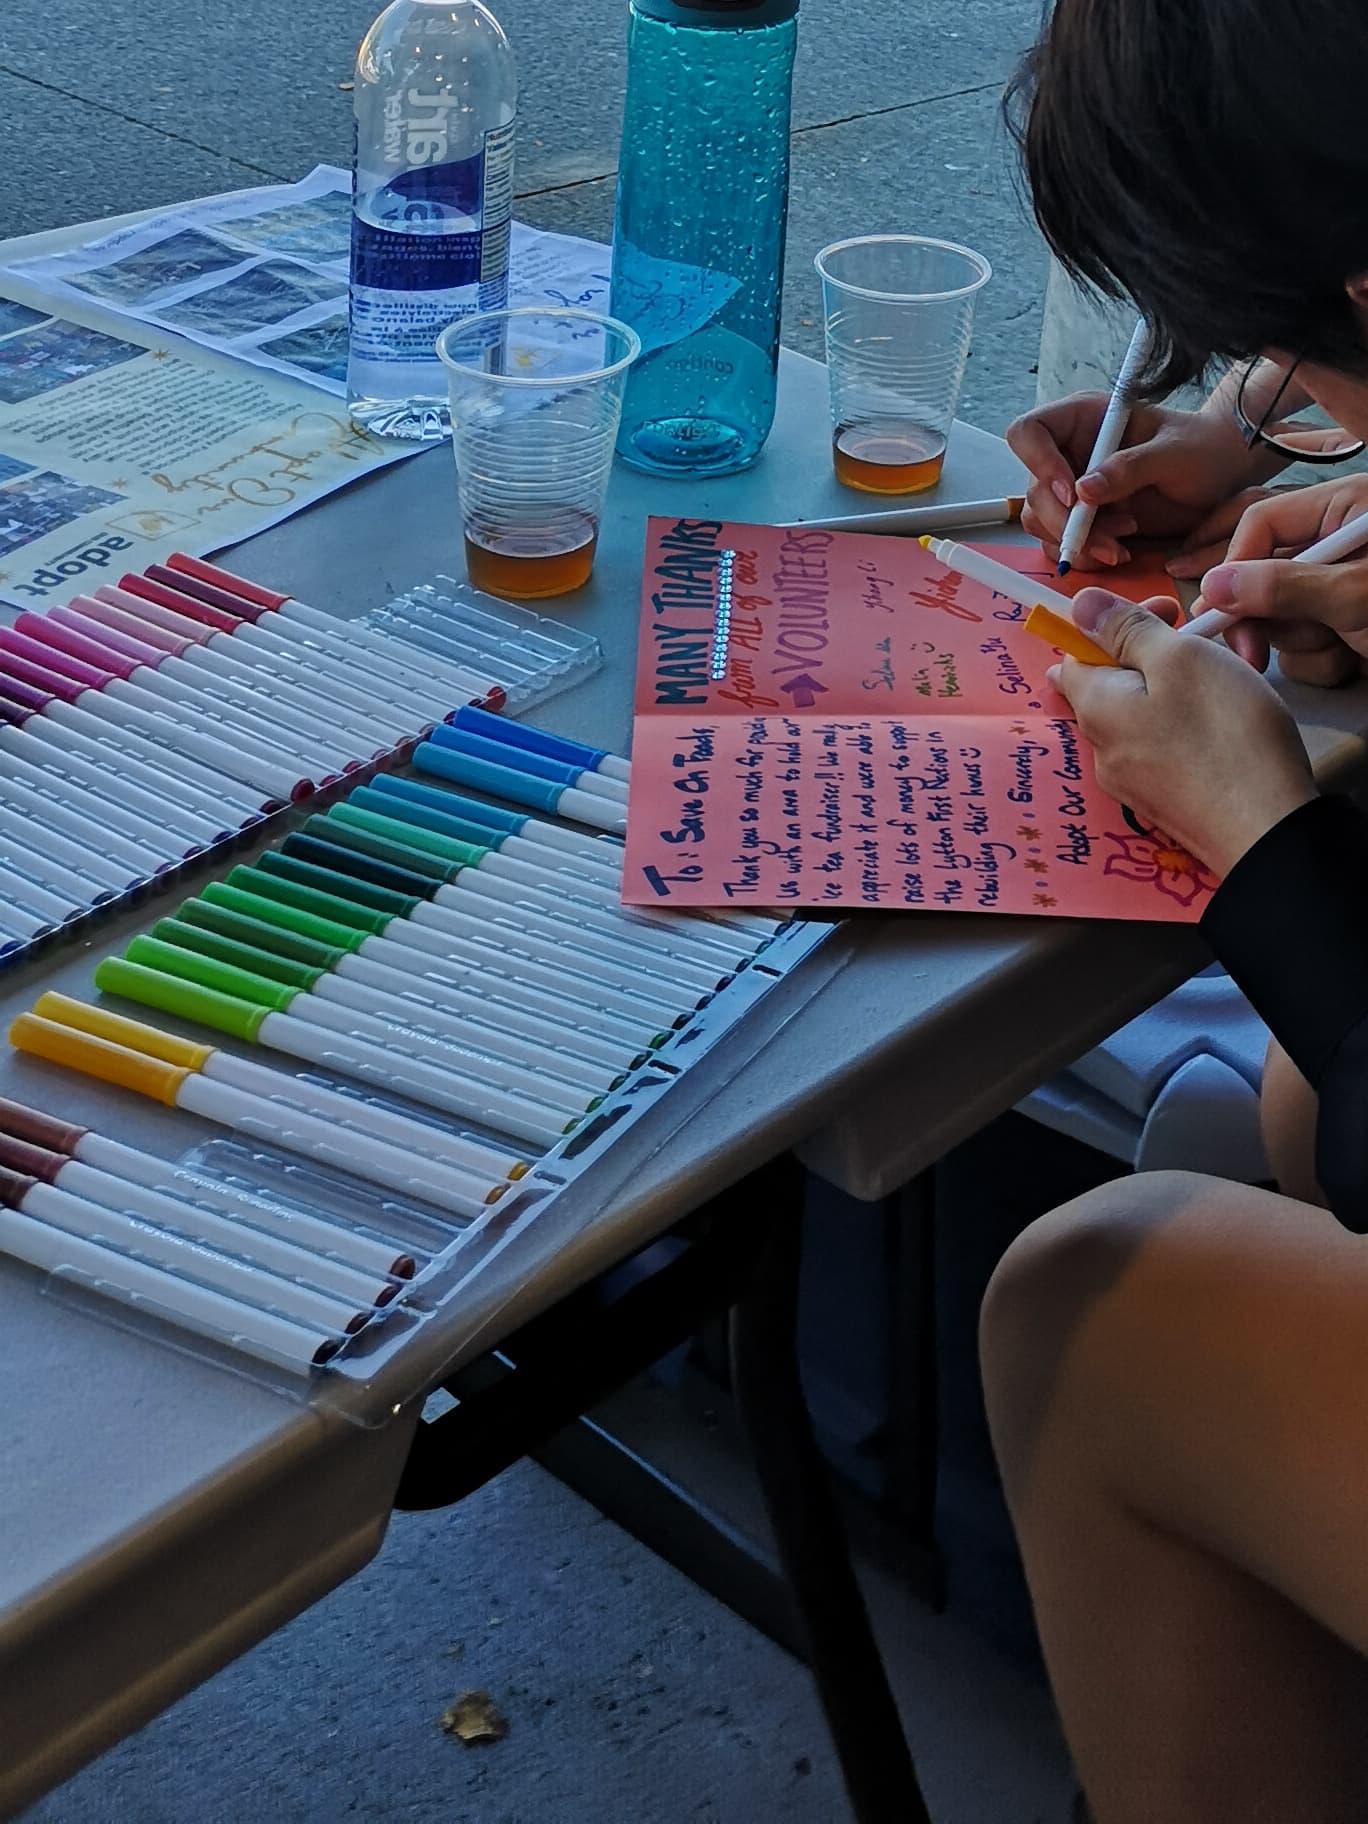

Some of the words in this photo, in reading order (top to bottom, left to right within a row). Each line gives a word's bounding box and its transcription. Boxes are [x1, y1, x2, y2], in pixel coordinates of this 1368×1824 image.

[12, 535, 134, 596] adopt
[651, 519, 723, 614] THANKS
[736, 551, 758, 585] our
[733, 593, 772, 611] of
[771, 530, 834, 674] VOLUNTEERS
[728, 617, 762, 651] ALL
[652, 623, 713, 704] MANY
[996, 654, 1031, 694] Selina
[717, 659, 779, 709] from
[782, 718, 800, 736] our
[672, 726, 719, 767] Foods,
[736, 748, 764, 767] for
[776, 742, 801, 763] hold
[817, 752, 838, 766] We
[846, 735, 872, 754] able
[1050, 719, 1082, 780] Community
[775, 769, 800, 781] to
[858, 761, 874, 788] were
[888, 755, 909, 770] to
[924, 747, 949, 789] Nations
[1007, 740, 1049, 802] Sincerely,
[673, 771, 709, 793] On
[736, 771, 763, 802] much
[959, 763, 984, 796] homes
[782, 790, 799, 816] area
[811, 773, 844, 842] fundraiser!!
[852, 795, 876, 818] and
[894, 777, 925, 814] money
[926, 796, 953, 821] First
[1058, 785, 1085, 816] Our
[660, 800, 705, 844] Save
[739, 807, 759, 821] so
[886, 819, 917, 836] of
[963, 803, 988, 835] their
[742, 827, 781, 855] you
[787, 823, 800, 839] an
[1056, 823, 1099, 865] Adopt
[778, 846, 802, 873] with
[813, 852, 844, 872] tea
[895, 842, 920, 865] lots
[933, 828, 971, 869] Lytton
[723, 856, 760, 897] Thank
[853, 840, 891, 901] appreciate
[974, 842, 1016, 906] rebuilding
[776, 881, 800, 897] us
[811, 883, 842, 901] ice
[902, 873, 924, 903] raise
[933, 880, 962, 904] the
